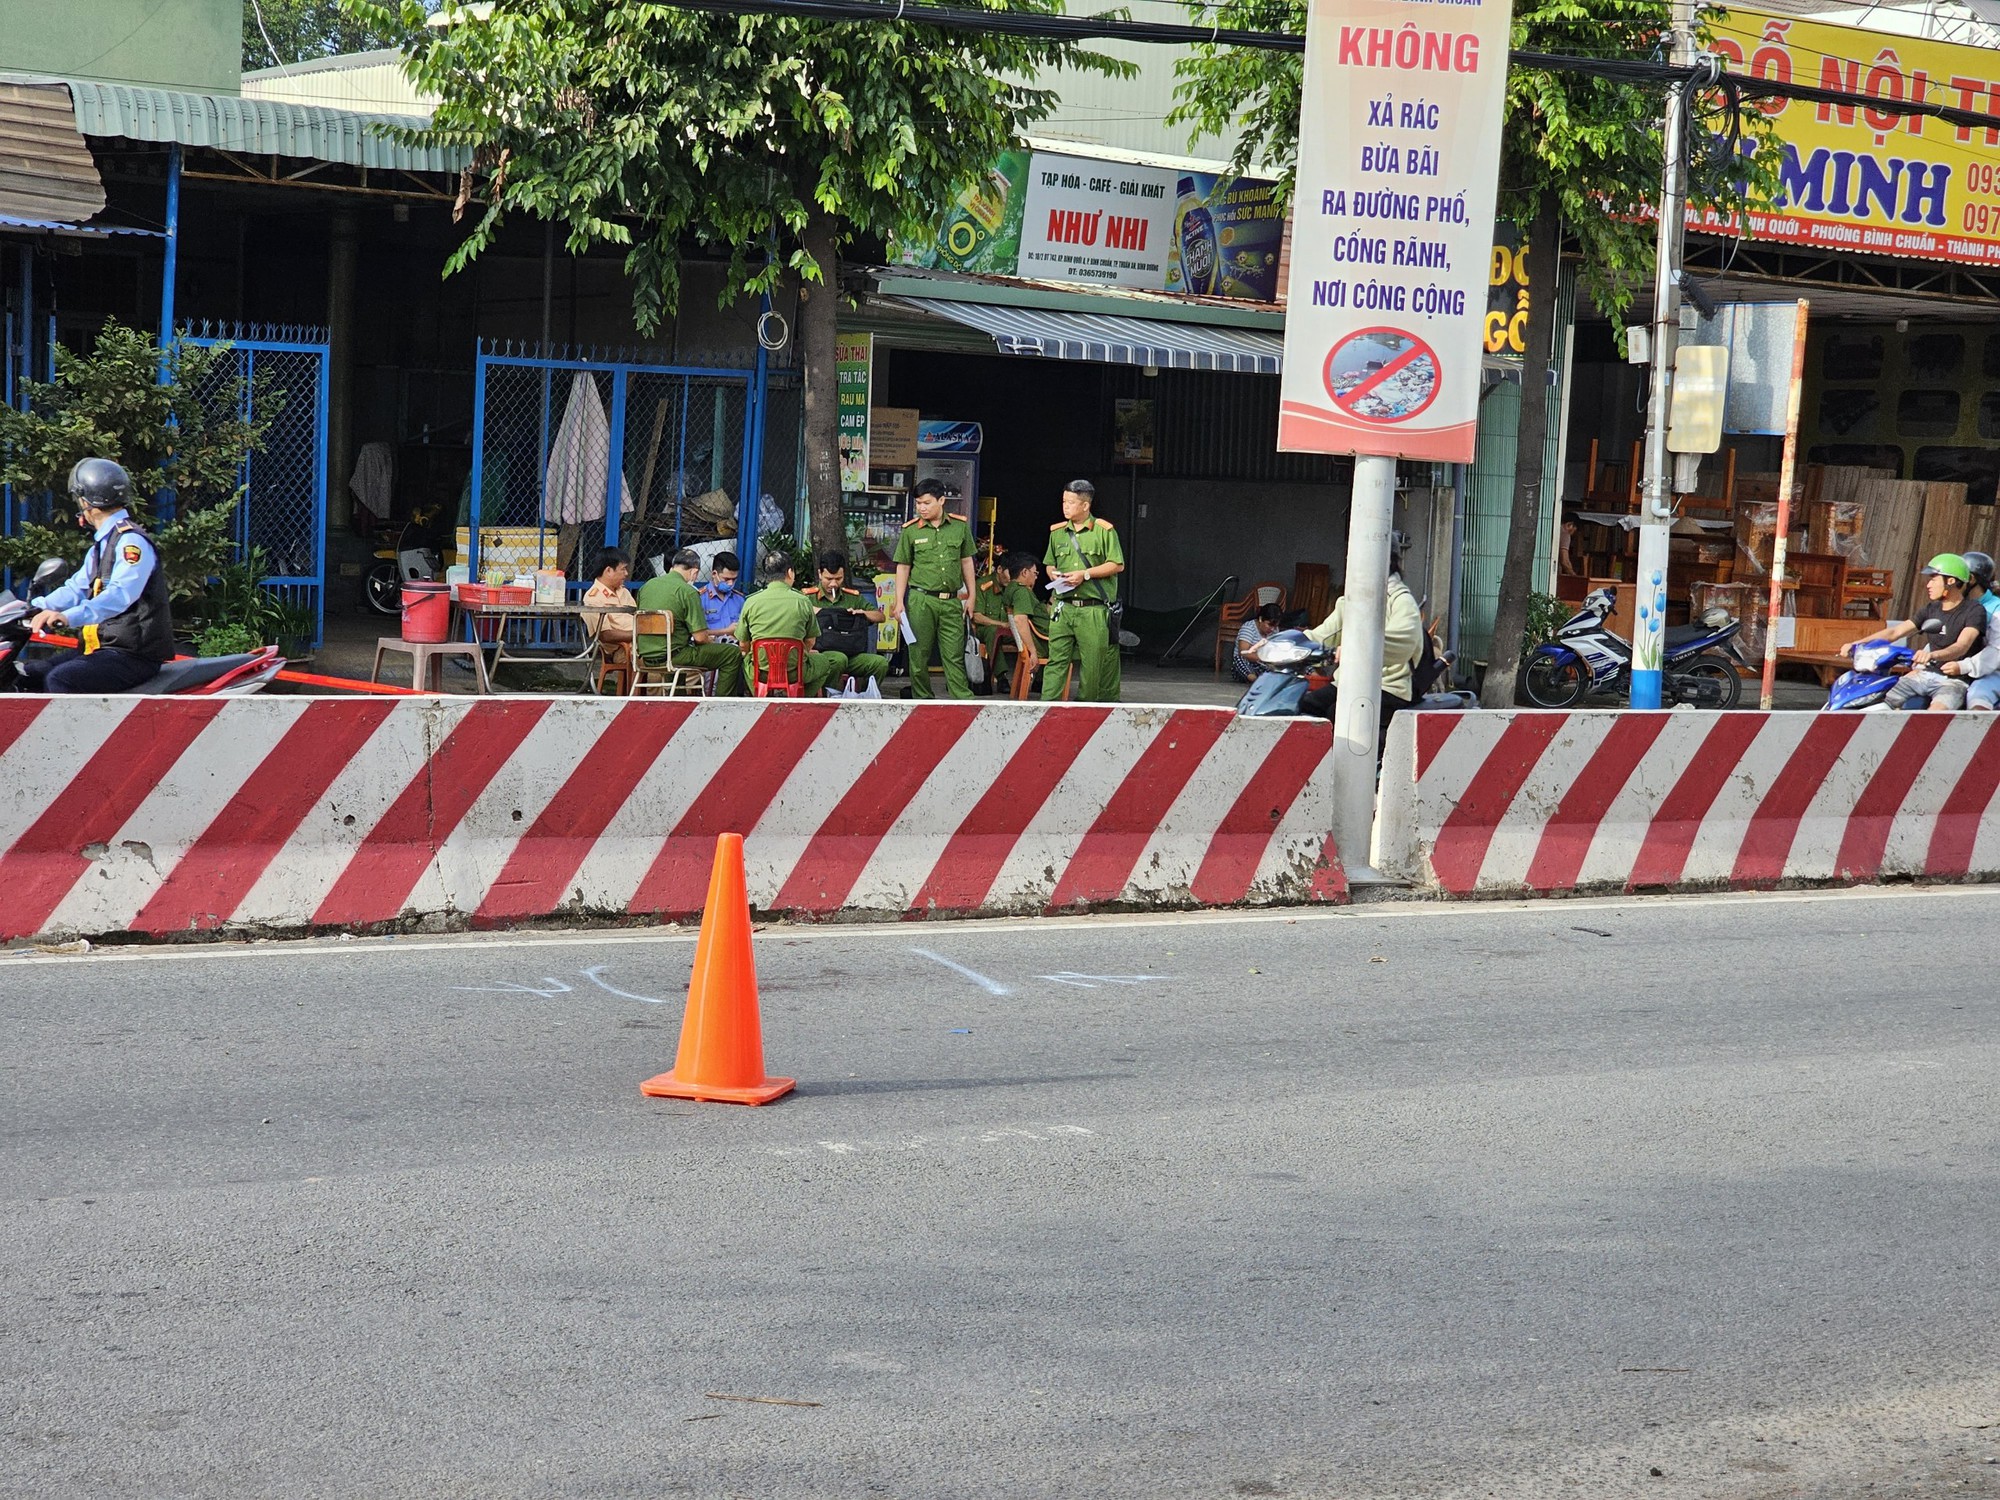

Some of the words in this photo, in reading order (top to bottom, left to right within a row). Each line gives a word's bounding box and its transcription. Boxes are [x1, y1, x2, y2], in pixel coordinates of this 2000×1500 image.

[1339, 22, 1480, 73] KHÔNG
[1368, 93, 1393, 127] XẢ
[1400, 98, 1439, 130] RÁC
[1816, 49, 1927, 146] NỘI
[1361, 142, 1399, 173] BỪA
[1406, 145, 1439, 176] BÃI
[1041, 172, 1059, 189] TẠP
[1061, 173, 1080, 189] HÓA
[1089, 175, 1111, 193] CAFÉ
[1119, 178, 1138, 196] GIẢI
[1141, 182, 1165, 199] KHÁT
[1773, 144, 1952, 227] MINH
[1322, 189, 1346, 216] RA
[1353, 187, 1419, 222] ĐƯỜNG
[1426, 189, 1470, 228] PHỐ,
[1047, 209, 1103, 246] NHƯ
[1105, 215, 1148, 251] NHI
[1334, 228, 1386, 264] CỐNG
[1392, 236, 1450, 272] RÃNH,
[1768, 218, 1800, 236] QUỚI
[1811, 223, 1860, 243] PHƯỜNG
[1863, 229, 1893, 247] BÌNH
[1895, 232, 1936, 252] CHUẨN
[1947, 238, 1984, 257] THÀNH
[1312, 280, 1346, 307] NƠI
[1353, 278, 1405, 311] CÔNG
[1412, 283, 1465, 319] CỘNG
[841, 414, 855, 427] CAM
[856, 412, 865, 427] ÉP
[1671, 650, 1696, 662] YAMAHA
